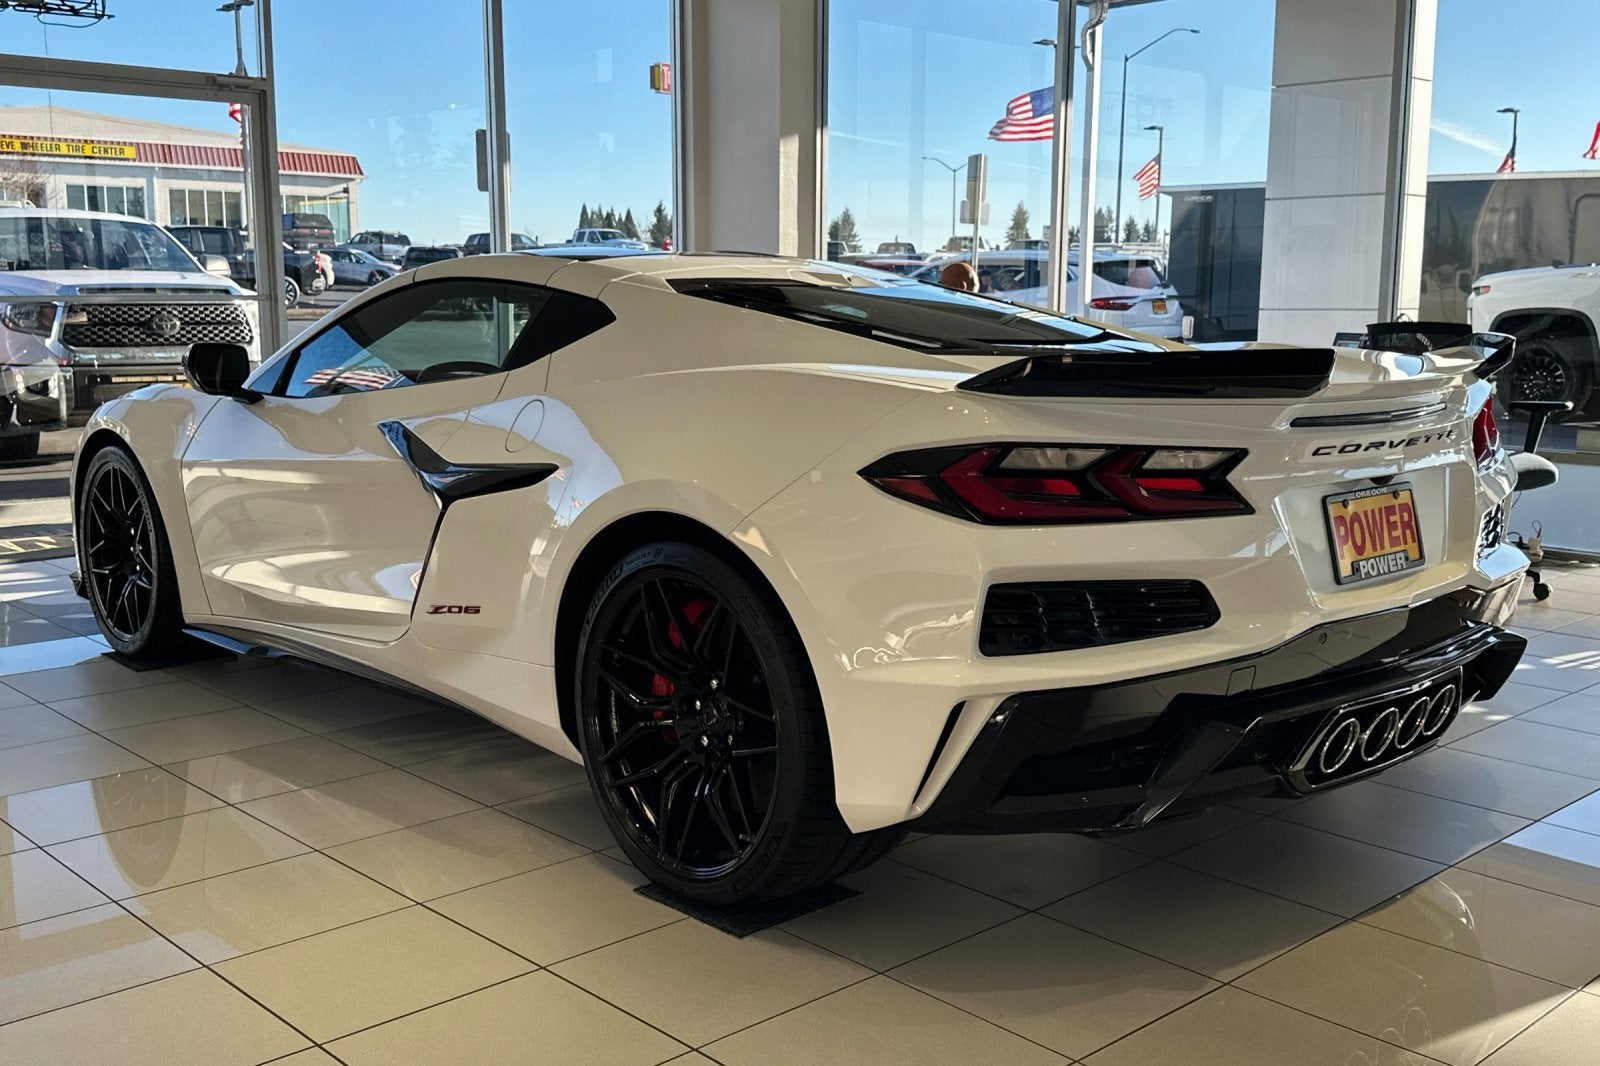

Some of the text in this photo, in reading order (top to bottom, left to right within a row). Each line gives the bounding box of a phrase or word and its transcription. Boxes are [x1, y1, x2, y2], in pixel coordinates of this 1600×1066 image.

[20, 142, 61, 152] WHEELER
[66, 144, 86, 154] TIRE
[92, 145, 125, 156] CENTER
[1311, 428, 1460, 456] CORVETTE
[1355, 487, 1388, 499] OREGON
[1333, 502, 1417, 560] POWER
[1358, 551, 1407, 579] POWER
[426, 604, 481, 615] Z06
